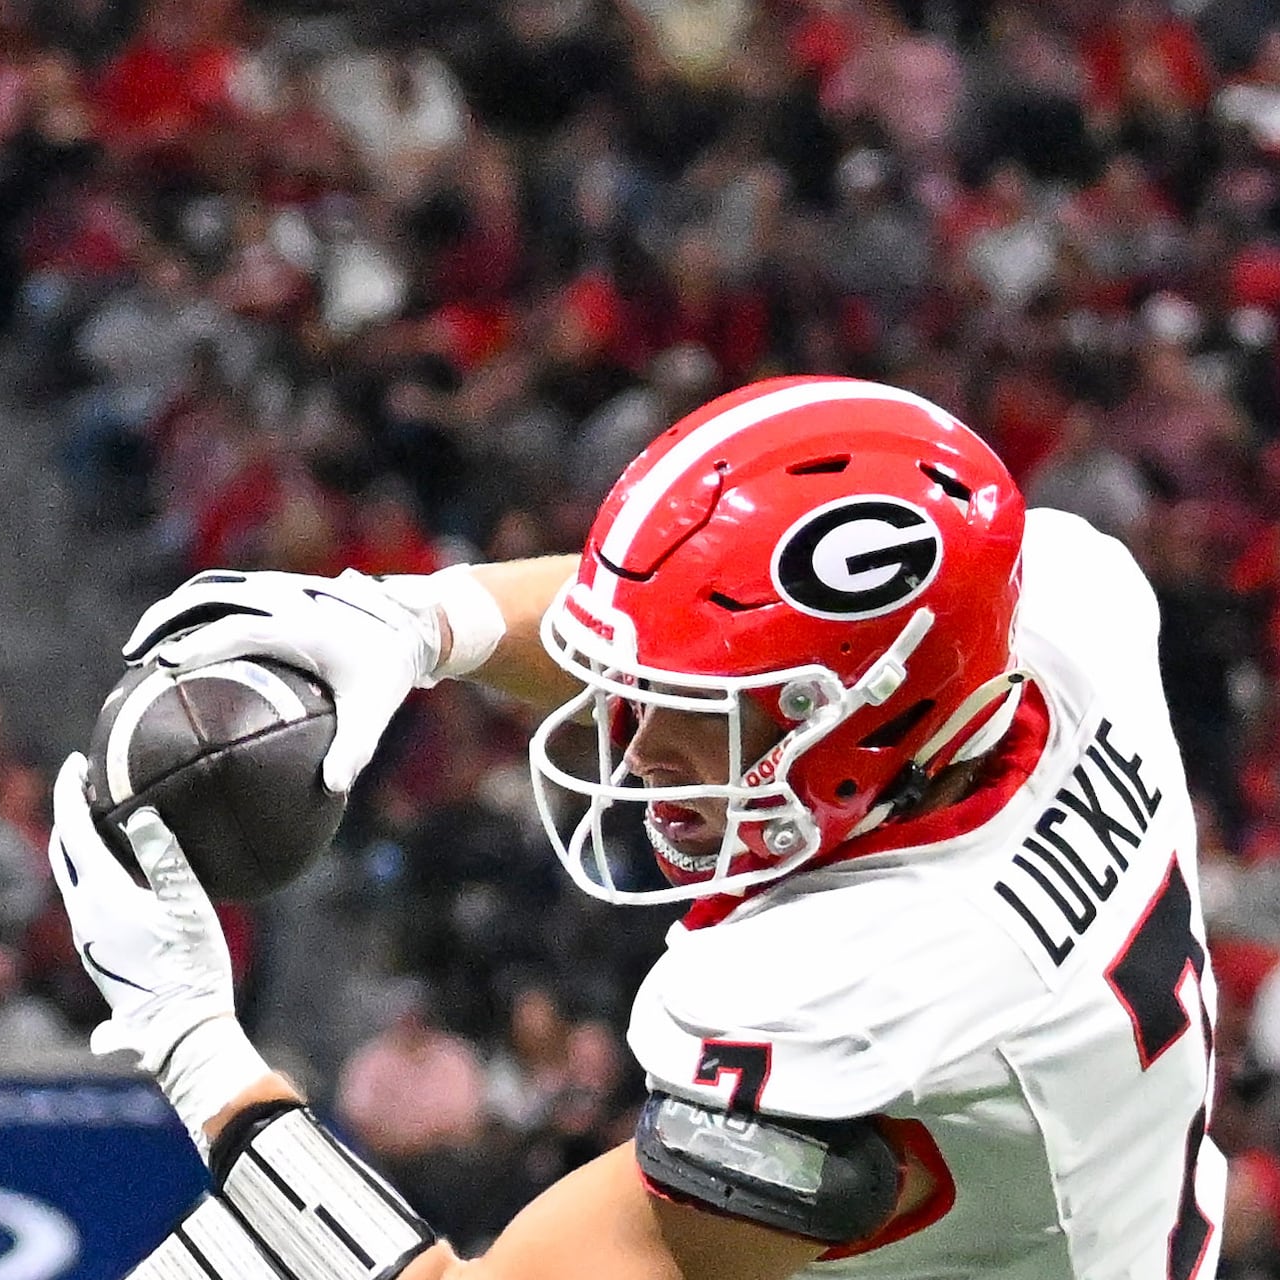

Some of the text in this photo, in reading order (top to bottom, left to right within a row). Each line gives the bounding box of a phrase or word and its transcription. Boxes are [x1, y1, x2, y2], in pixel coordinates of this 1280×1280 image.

[777, 501, 937, 614] G
[993, 717, 1163, 968] LUCKIE
[693, 1037, 773, 1116] 7
